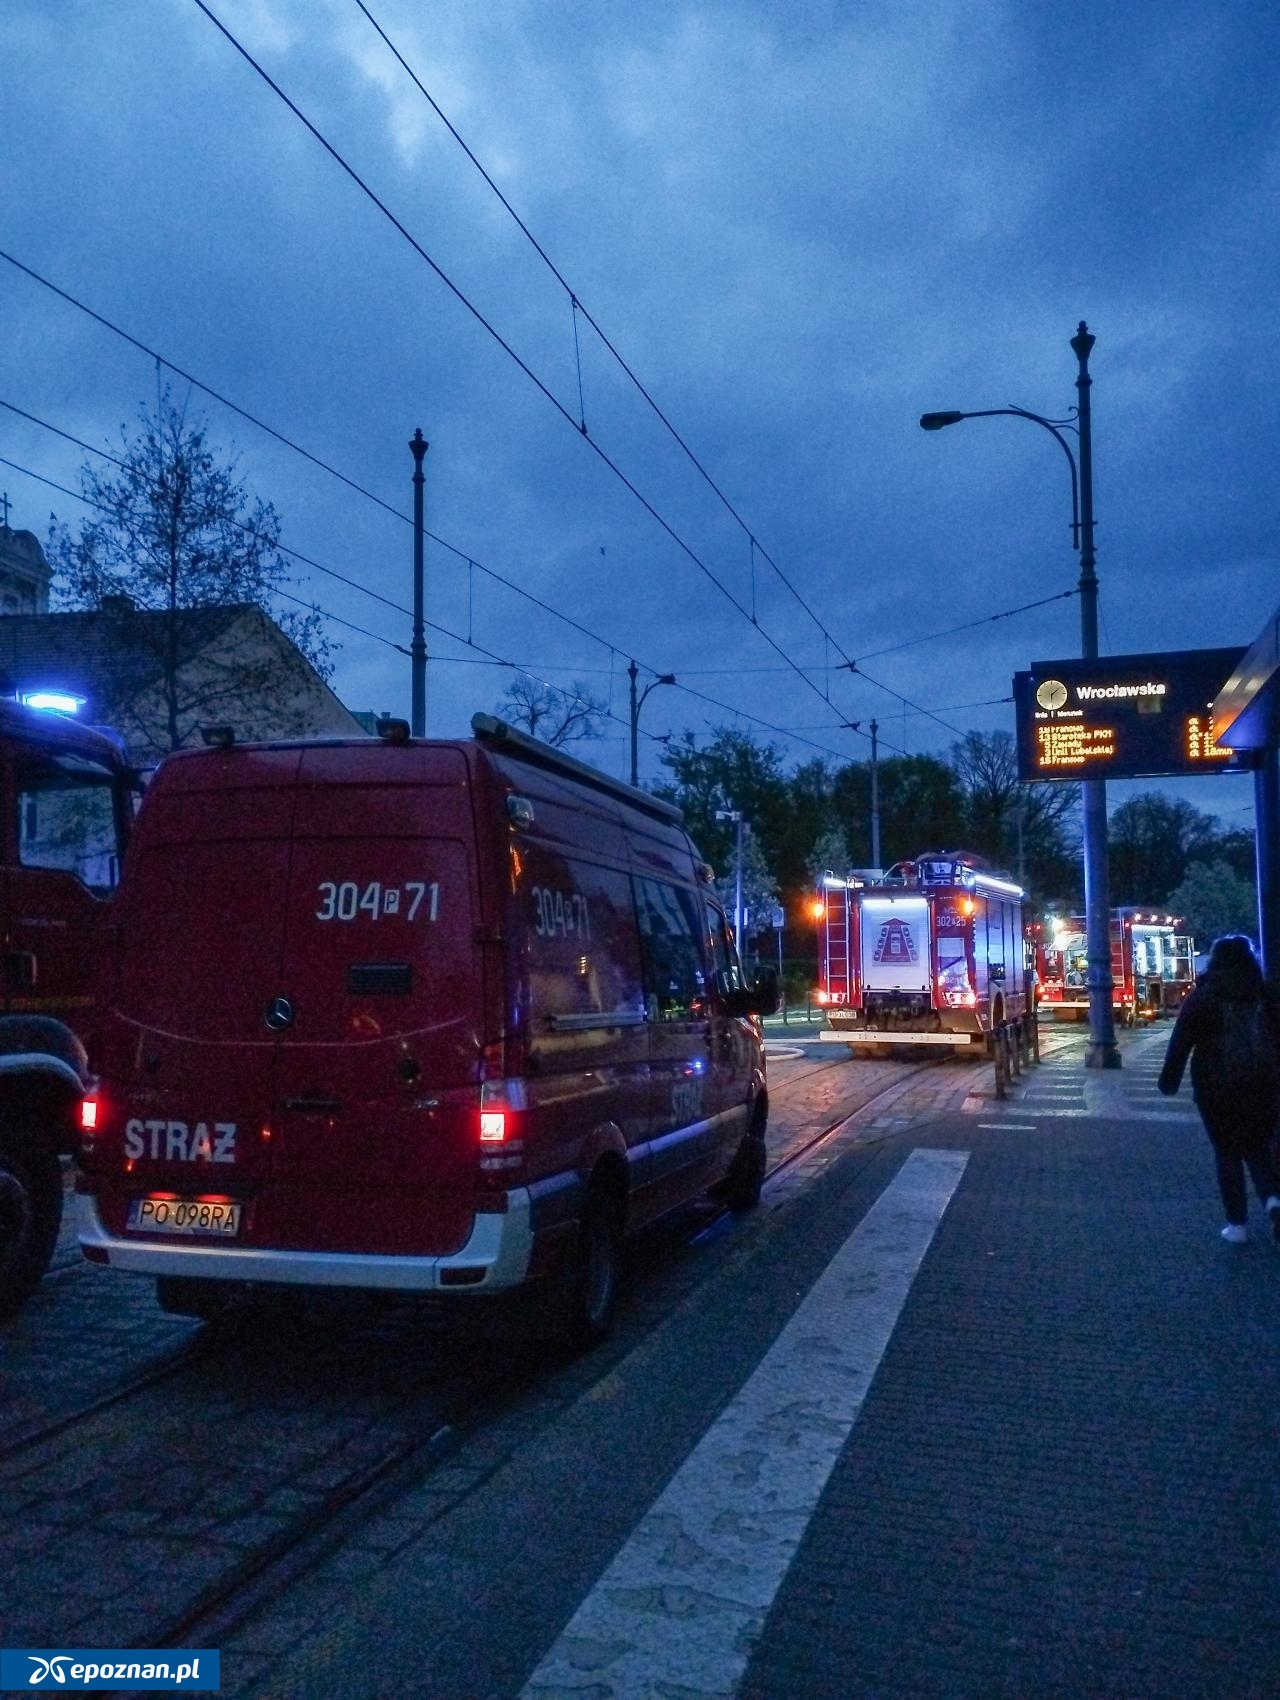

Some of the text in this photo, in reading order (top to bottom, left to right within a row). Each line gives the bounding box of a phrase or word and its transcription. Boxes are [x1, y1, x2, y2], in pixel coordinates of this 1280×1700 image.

[1076, 682, 1166, 699] Wrocławska
[1039, 734, 1050, 742] 13
[1052, 756, 1085, 764] Franowo
[140, 1201, 235, 1230] PO 098RA
